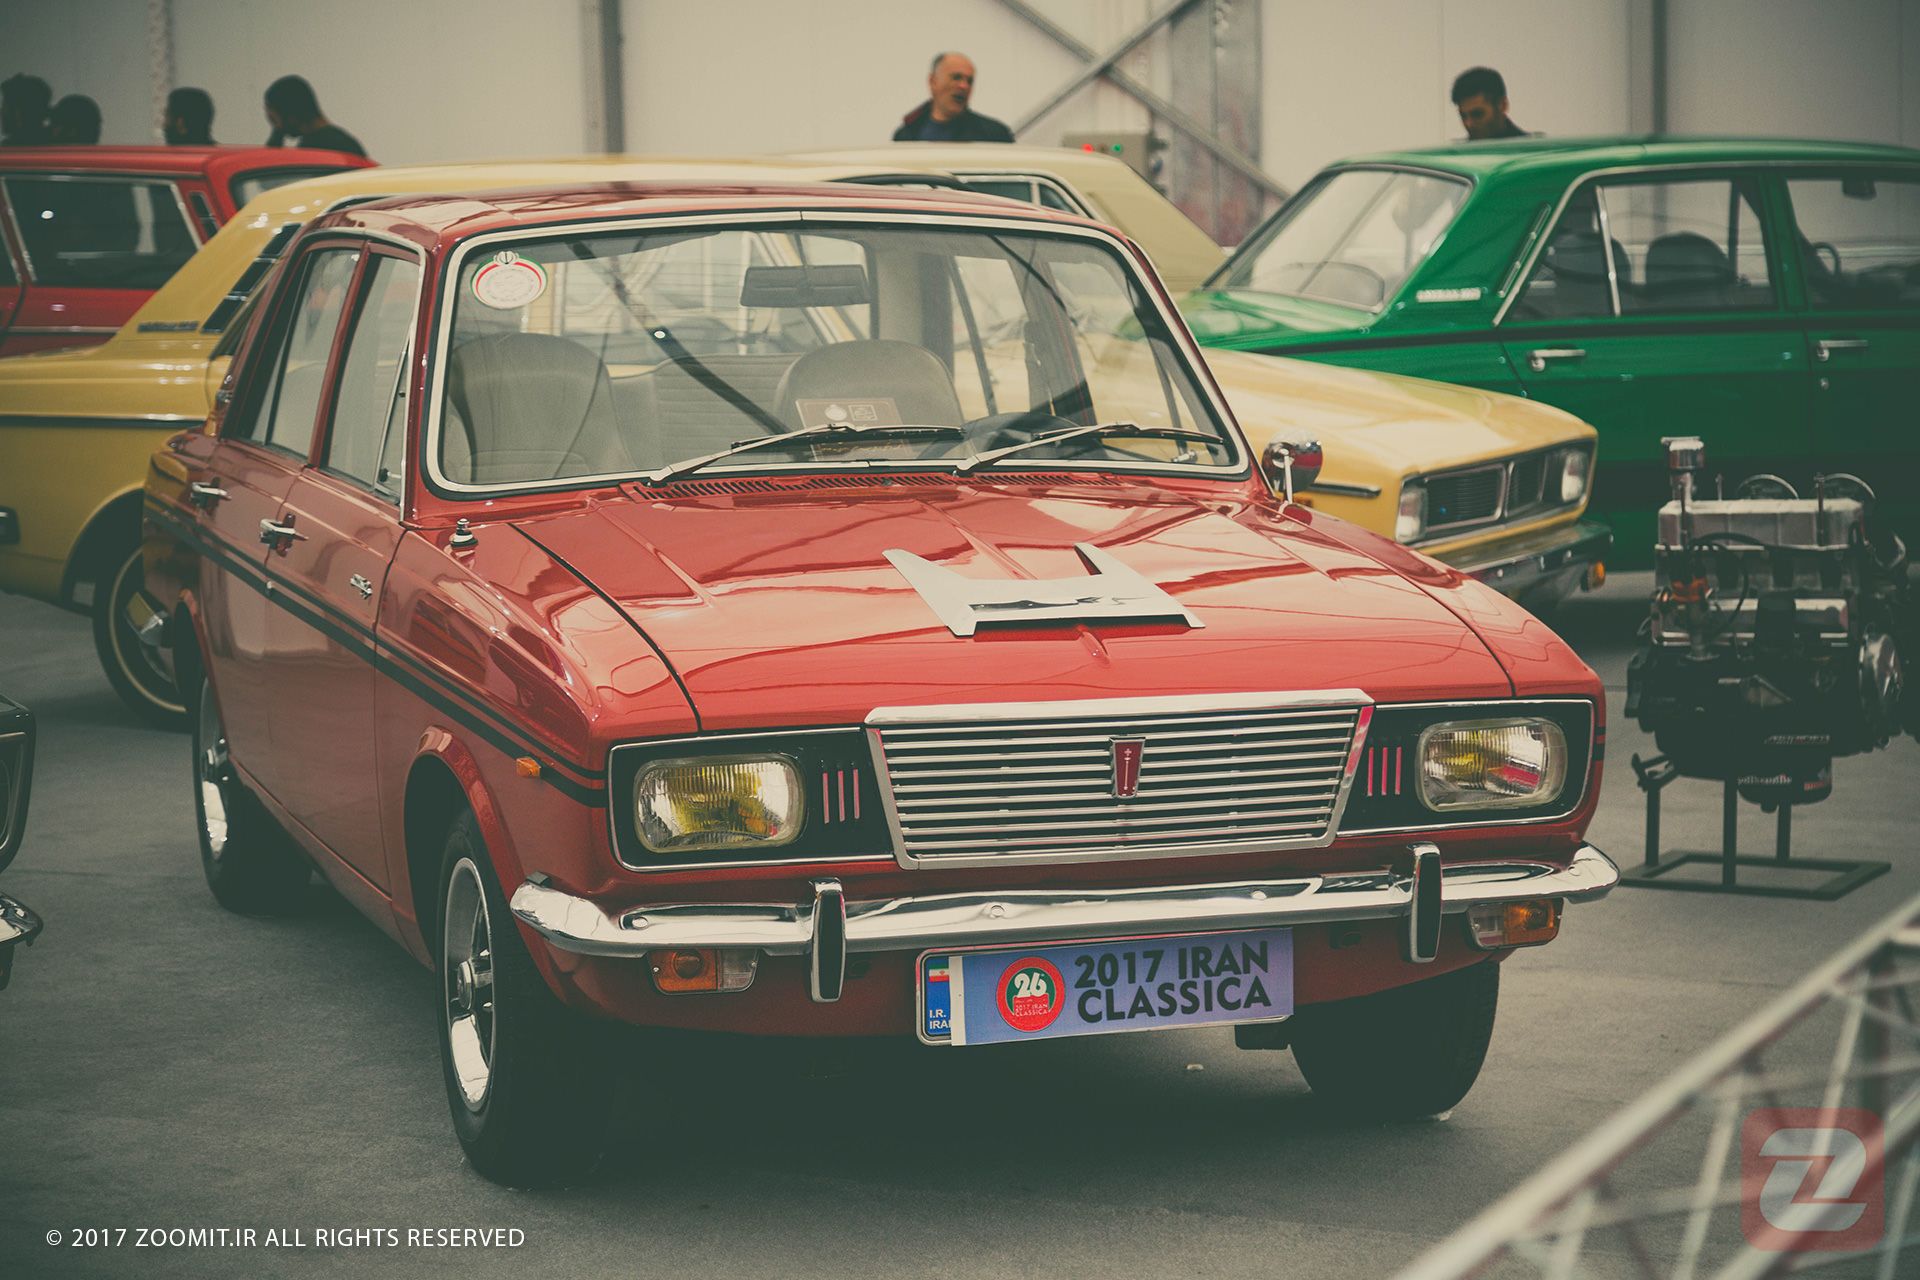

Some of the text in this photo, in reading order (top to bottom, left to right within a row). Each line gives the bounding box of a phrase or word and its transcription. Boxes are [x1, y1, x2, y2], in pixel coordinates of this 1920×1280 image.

[1014, 972, 1047, 998] 26
[1074, 941, 1269, 989] 2017 IRAN
[1077, 976, 1272, 1023] CLASSICA
